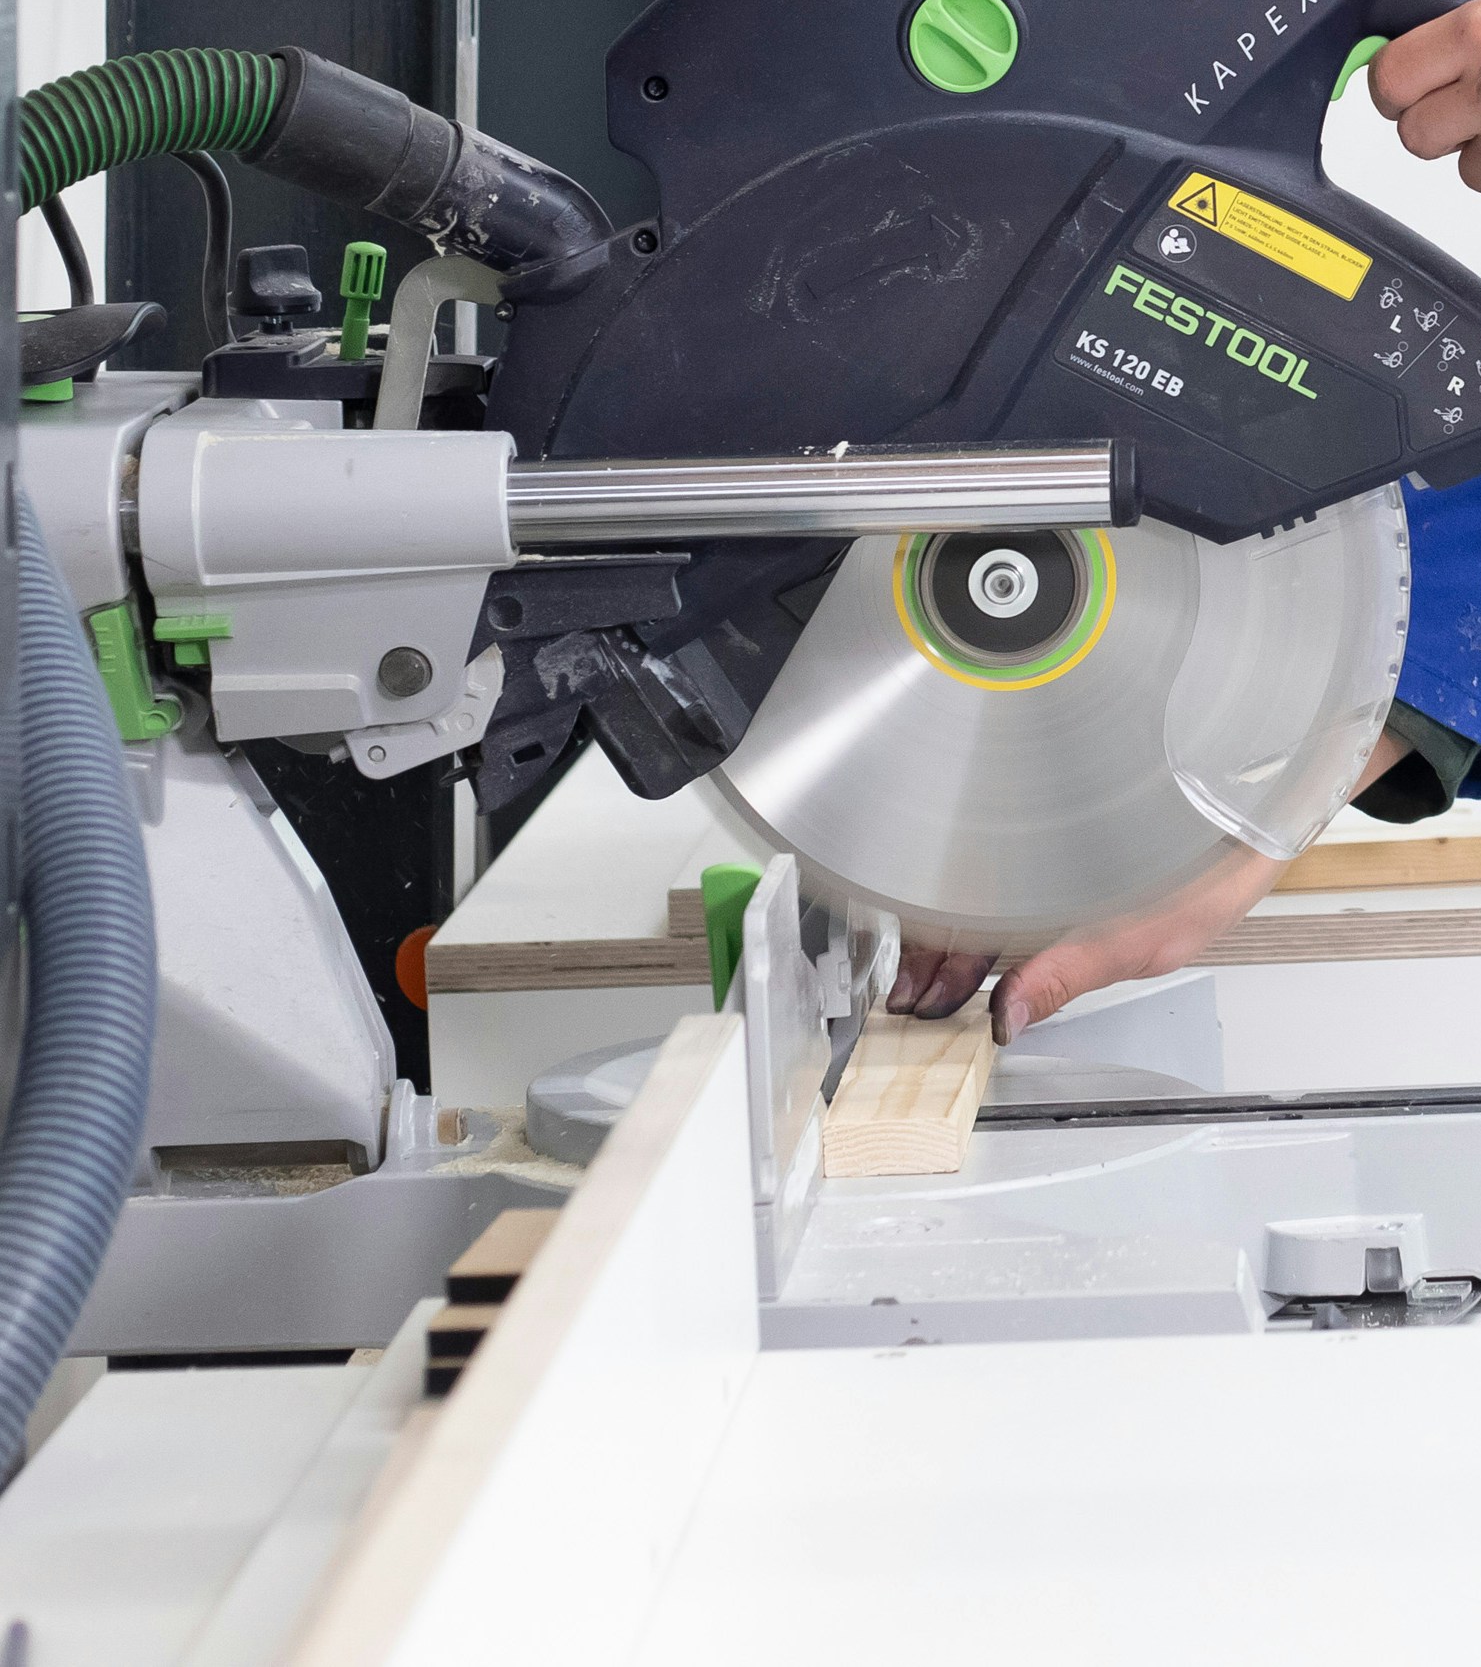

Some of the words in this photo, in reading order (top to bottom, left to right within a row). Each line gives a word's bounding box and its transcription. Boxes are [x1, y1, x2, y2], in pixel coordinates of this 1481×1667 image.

[1103, 263, 1318, 400] FESTOOL
[1389, 314, 1402, 334] L
[1069, 353, 1145, 396] www.festool.com
[1075, 330, 1110, 358] KS
[1112, 348, 1151, 380] 120
[1151, 368, 1184, 397] EB
[1446, 375, 1465, 397] R
